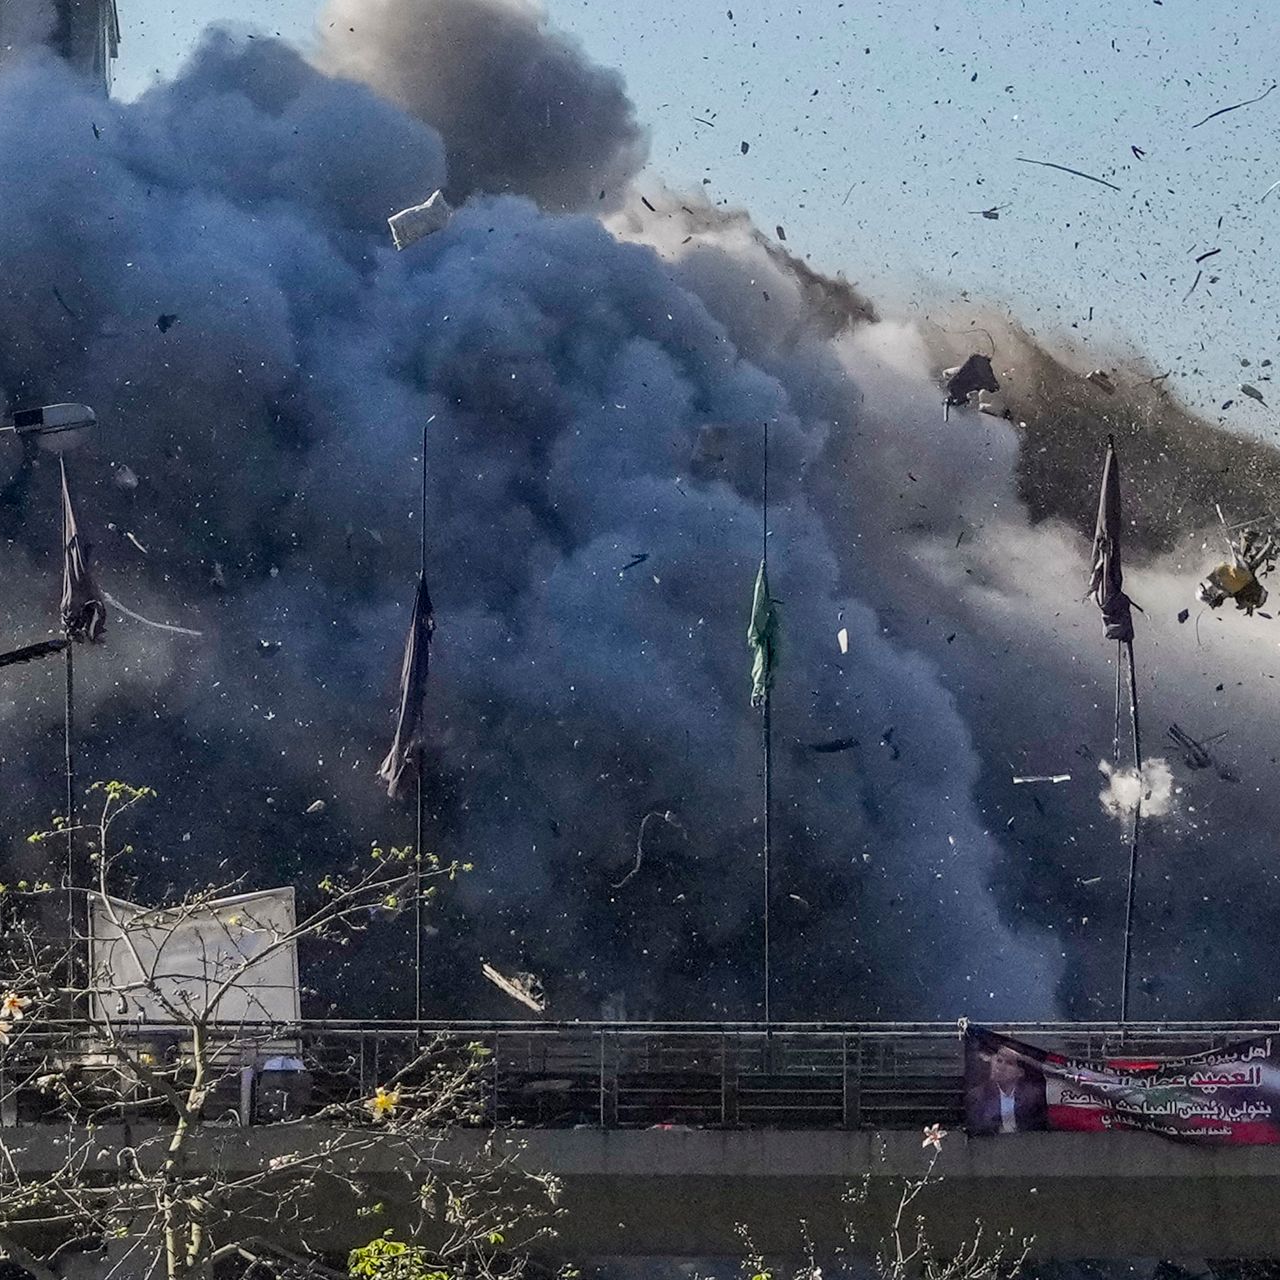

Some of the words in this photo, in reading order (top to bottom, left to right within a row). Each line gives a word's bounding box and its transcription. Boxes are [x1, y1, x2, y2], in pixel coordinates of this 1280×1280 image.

[1240, 1038, 1272, 1062] أهل
[1188, 1065, 1263, 1094] العميد
[1115, 1099, 1176, 1118] المباحث
[1179, 1100, 1225, 1119] رئيس
